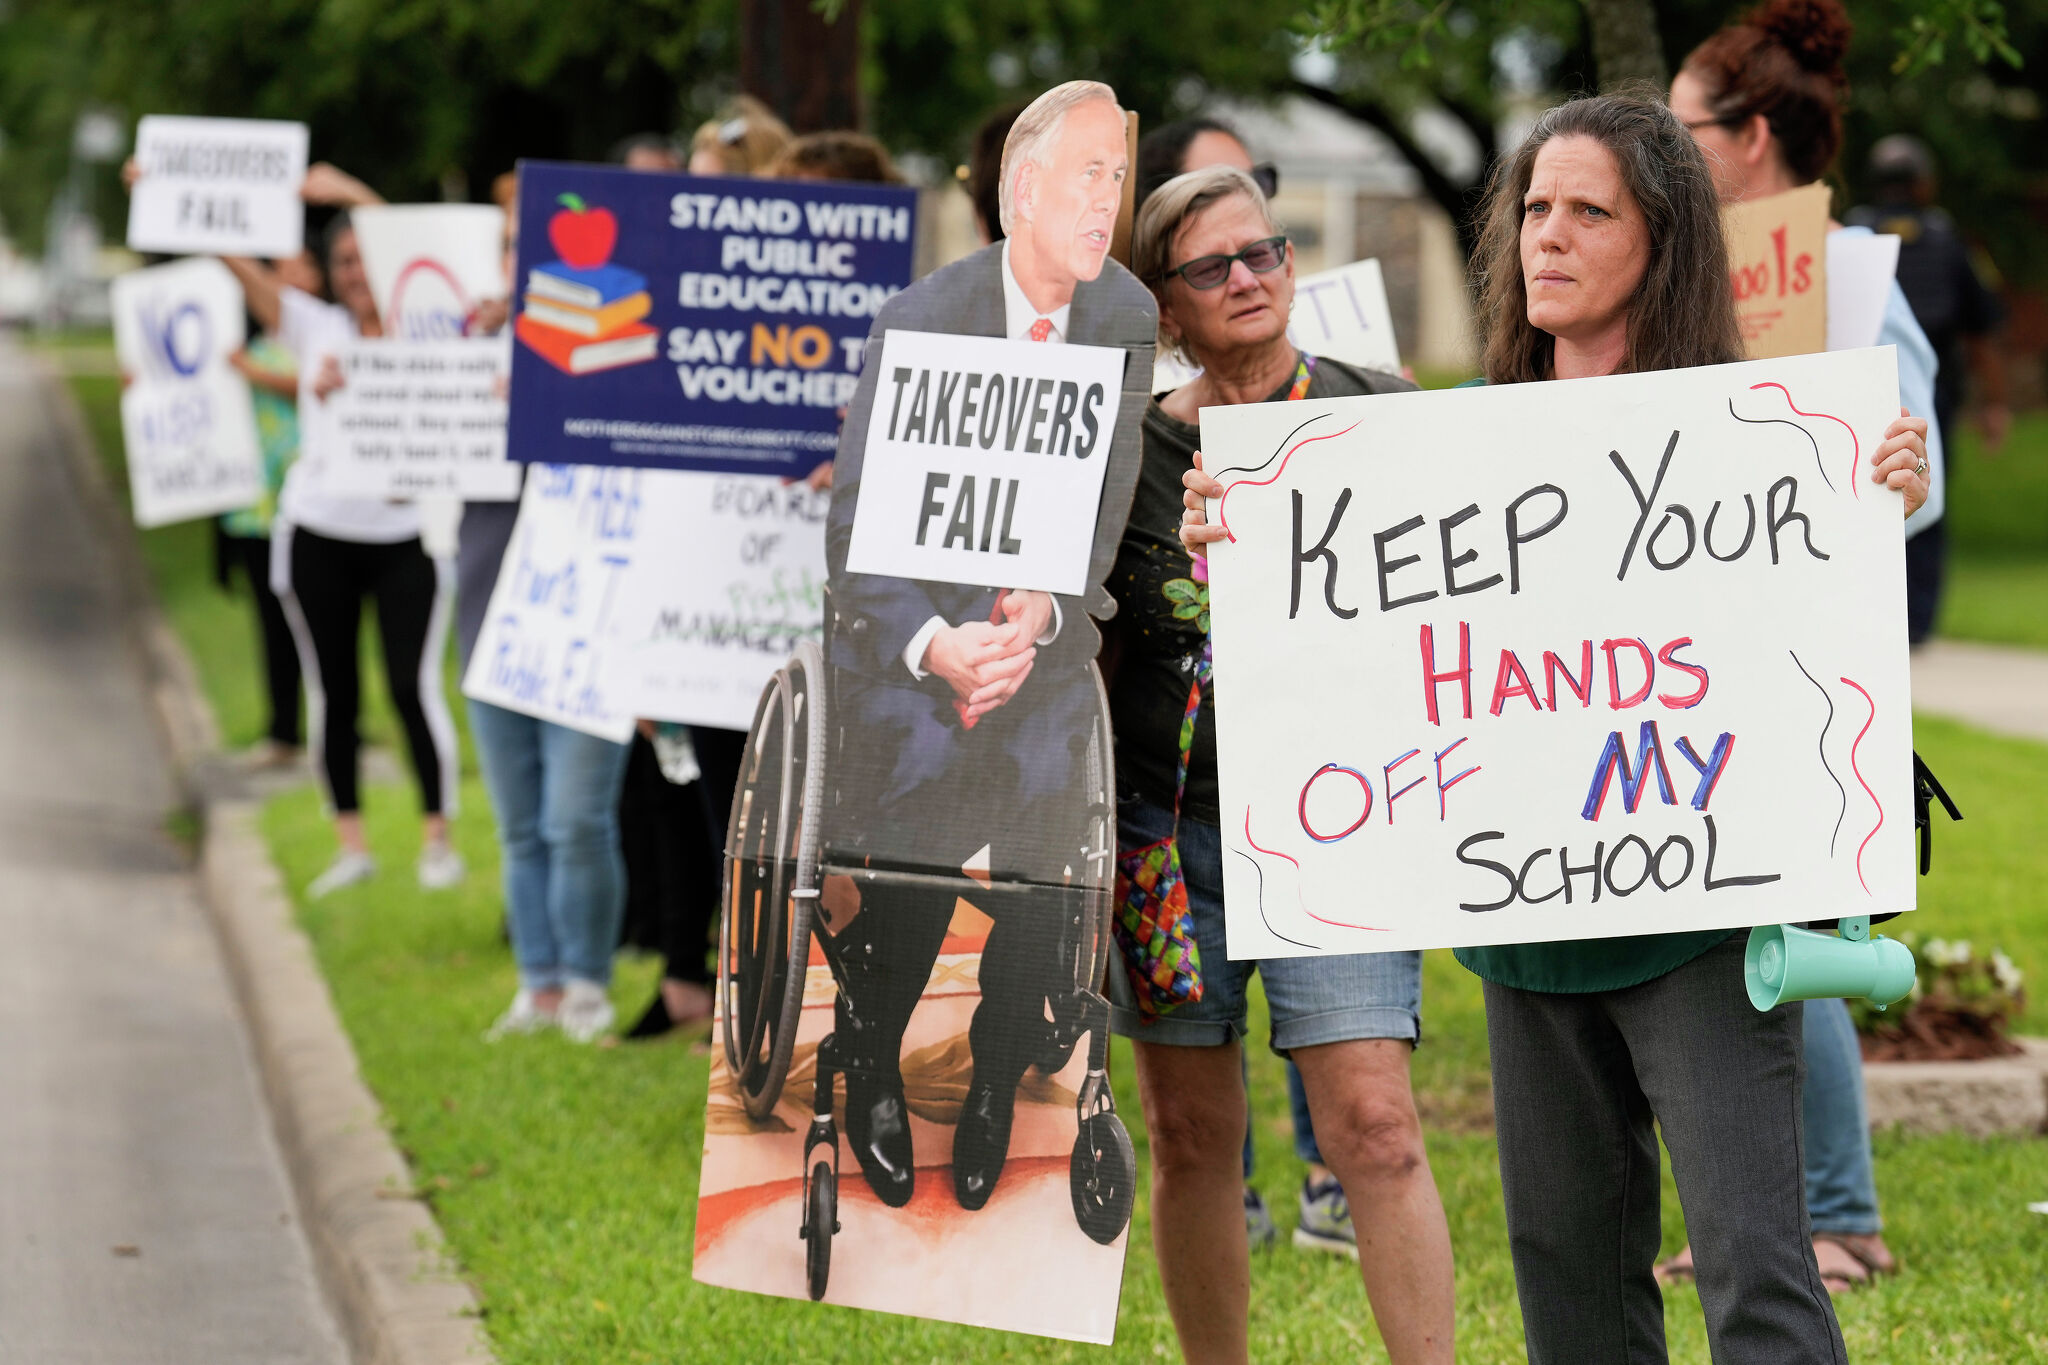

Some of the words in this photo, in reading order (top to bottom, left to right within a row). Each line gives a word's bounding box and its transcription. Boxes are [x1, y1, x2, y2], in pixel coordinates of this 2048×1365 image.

[176, 191, 253, 233] FAIL
[670, 192, 802, 235] STAND
[804, 201, 911, 242] WITH
[721, 234, 856, 278] PUBLIC
[1728, 221, 1814, 300] ools
[667, 326, 746, 365] SAY
[750, 321, 833, 370] NO
[839, 337, 868, 372] T
[676, 364, 859, 408] VOUCHER
[888, 367, 1104, 459] TAKEOVERS
[712, 476, 831, 523] BOARD
[915, 472, 1022, 555] FAIL
[1288, 483, 1569, 619] KEEP
[1608, 430, 1831, 581] YOUR
[739, 532, 783, 564] OF
[1420, 620, 1709, 726] HANDS
[1298, 736, 1481, 843] OFF
[1581, 720, 1735, 822] MY
[1456, 814, 1781, 912] SCHOOL
